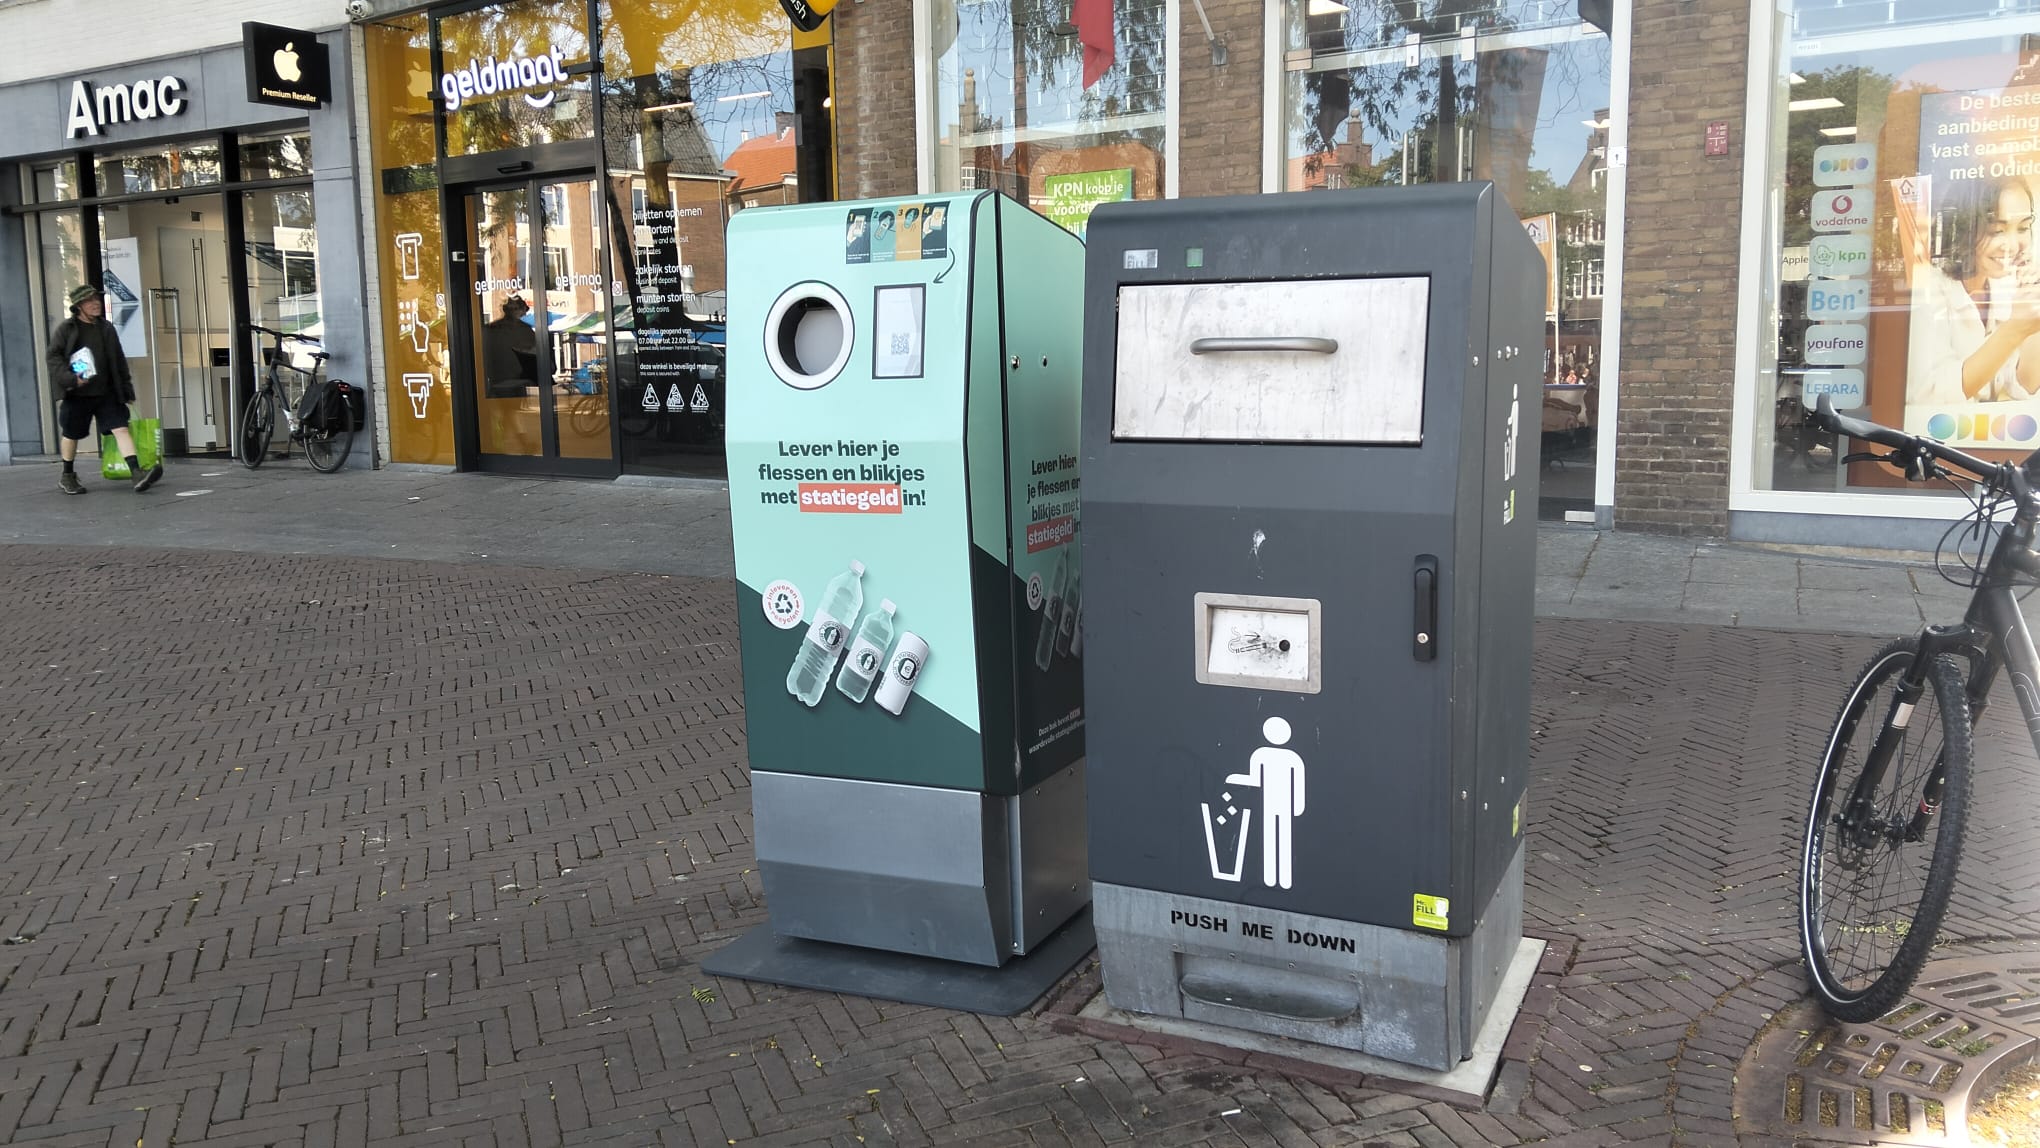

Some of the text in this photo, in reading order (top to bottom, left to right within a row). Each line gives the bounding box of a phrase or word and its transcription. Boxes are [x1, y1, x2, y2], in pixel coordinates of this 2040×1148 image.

[441, 44, 568, 110] geldmaat
[262, 87, 317, 103] Premium Reseller
[1960, 91, 2040, 111] De beste
[67, 75, 181, 139] Amac
[1932, 142, 1969, 158] vast
[1975, 143, 1997, 155] en
[1950, 166, 1984, 180] met
[1053, 181, 1083, 198] KPN
[1113, 181, 1124, 194] je
[665, 207, 702, 220] opnemen
[1815, 217, 1868, 226] vodafone
[1783, 256, 1809, 265] Apple
[1838, 250, 1867, 262] kpn
[635, 264, 693, 276] zakelijk storten
[636, 293, 696, 303] munten storten
[1811, 290, 1856, 311] Ben
[1807, 337, 1864, 352] youfone
[1806, 384, 1859, 394] LEBARA
[778, 440, 899, 461] Lever hier je
[1031, 454, 1076, 476] Lever hier
[758, 464, 925, 485] flessen en blikjes
[761, 489, 926, 510] met statiegeld in!
[1027, 484, 1036, 503] je
[1037, 480, 1070, 494] flessen
[1031, 497, 1079, 522] blikjes met
[1028, 519, 1073, 545] statiegeld
[1416, 904, 1436, 915] FILL
[1170, 910, 1356, 954] PUSH ME DOWN
